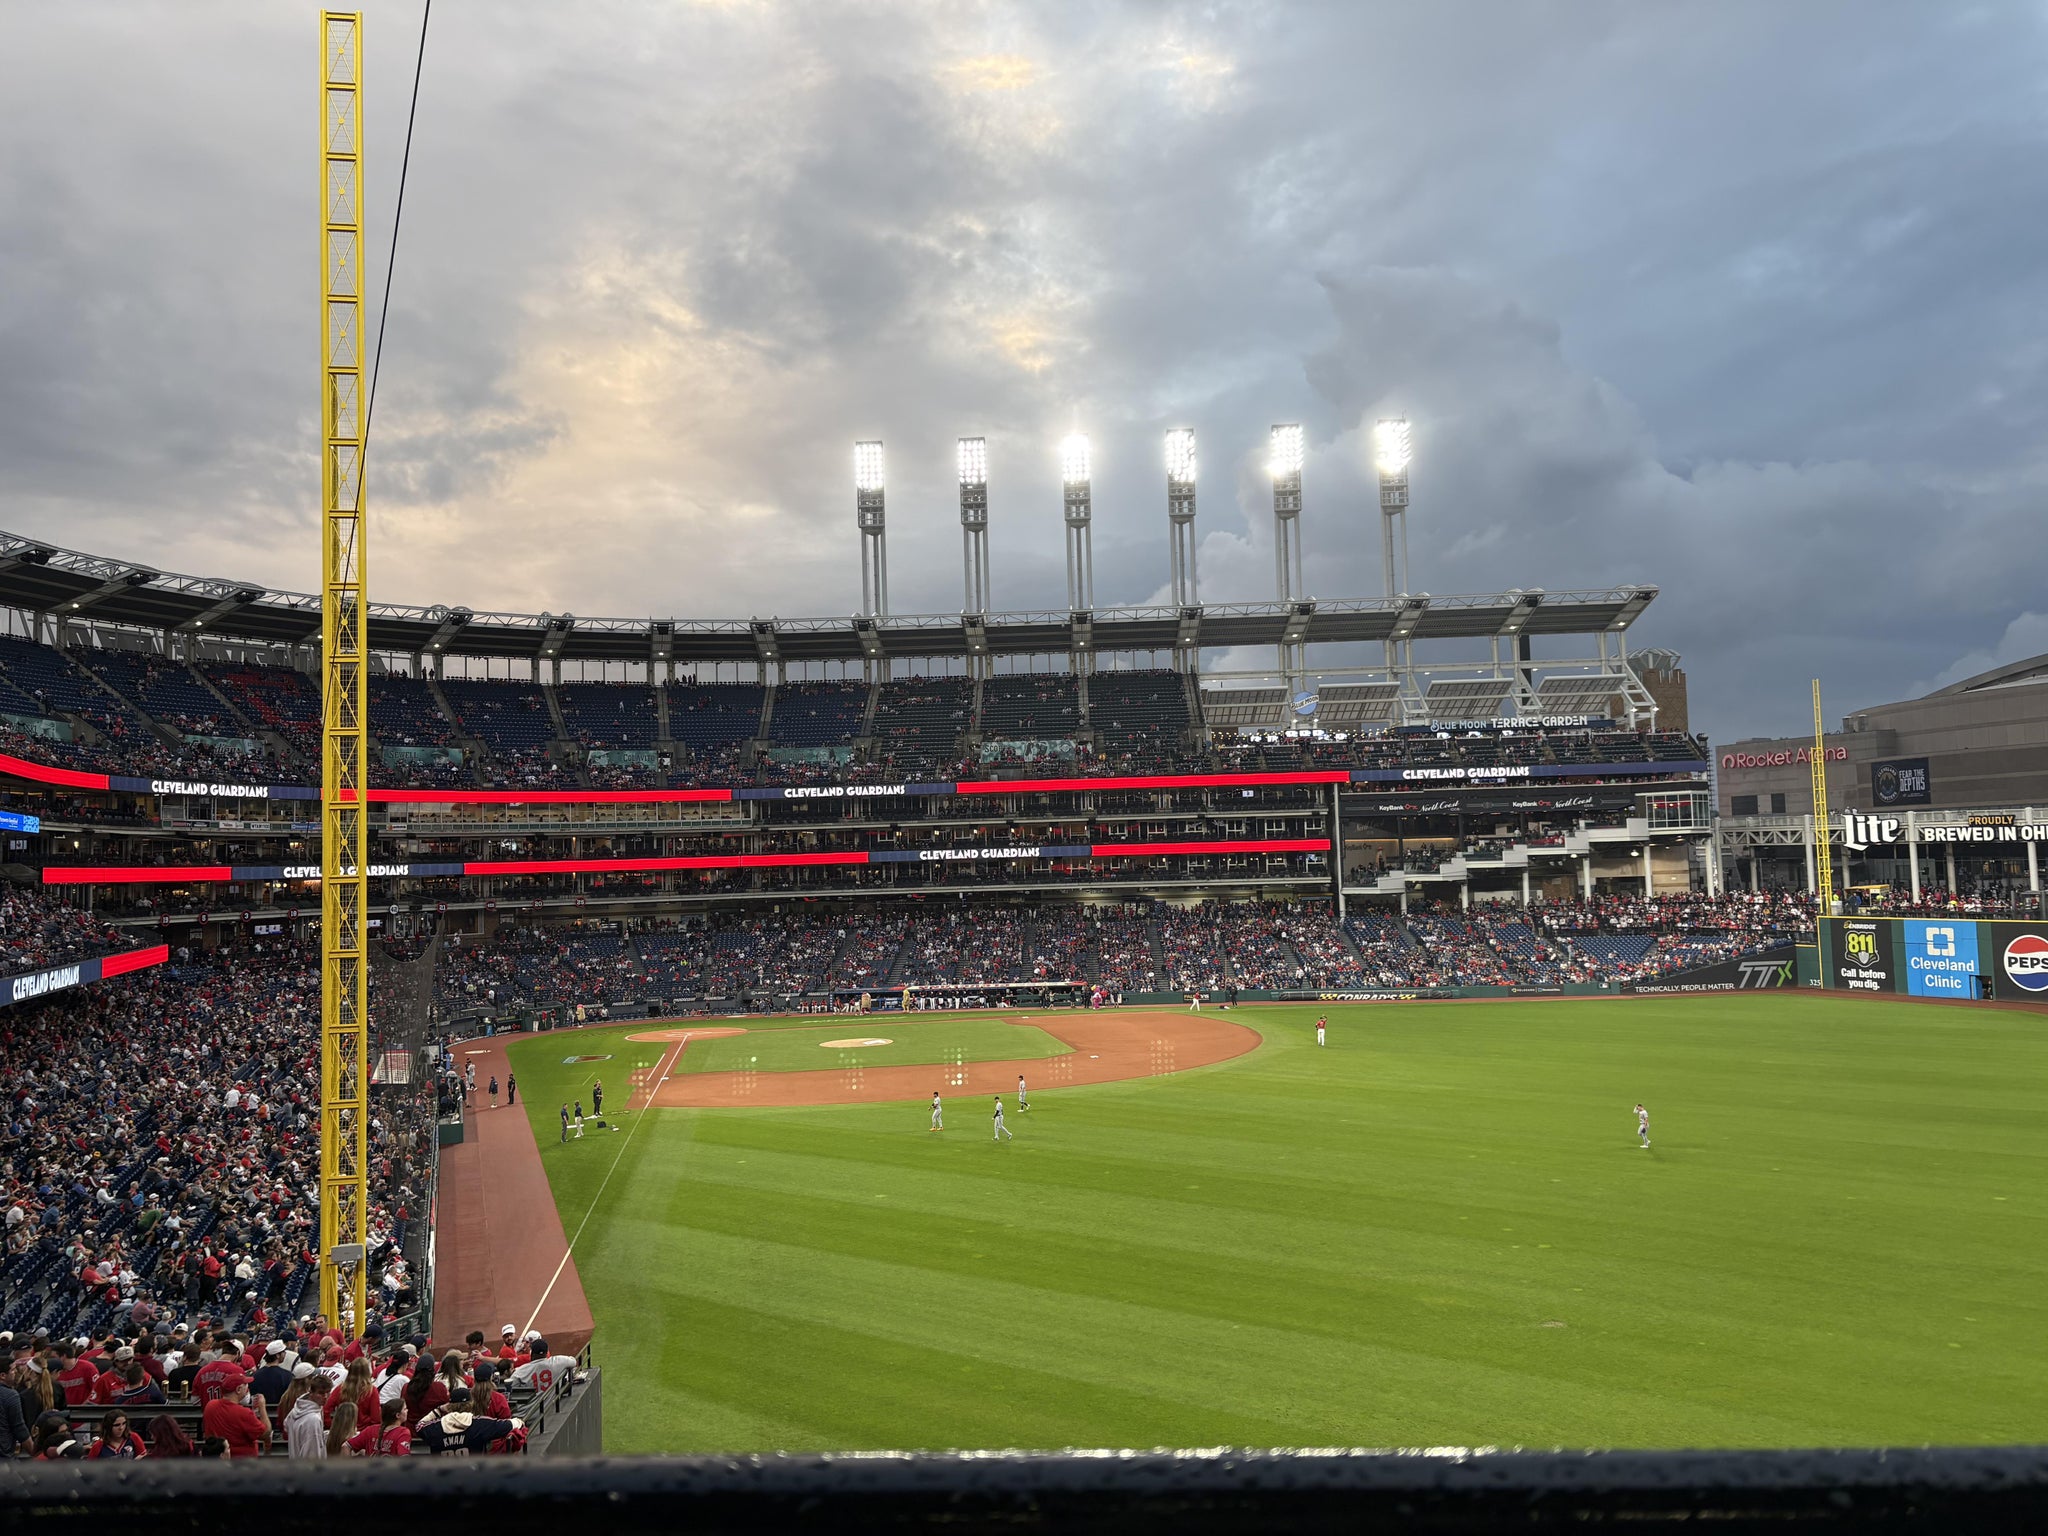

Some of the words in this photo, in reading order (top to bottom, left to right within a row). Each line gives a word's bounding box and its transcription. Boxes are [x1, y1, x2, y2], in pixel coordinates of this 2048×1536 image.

[1430, 719, 1457, 732] BLUE
[1459, 720, 1487, 730] MOON
[1490, 716, 1539, 729] TERRACE
[1542, 715, 1588, 727] GARDEN
[1737, 749, 1792, 768] Rocket
[1795, 746, 1848, 763] Arena
[1402, 769, 1465, 780] CLEVELAND
[1467, 766, 1530, 778] GUARDIANS
[1899, 769, 1912, 779] FEAR
[1914, 768, 1925, 778] THE
[151, 780, 208, 796] CLEVELAND
[209, 784, 268, 799] GUARDIANS
[784, 786, 844, 798] CLEVELAND
[846, 784, 905, 796] GUARDIANS
[1900, 777, 1926, 792] DEPTHS
[1379, 804, 1404, 812] KeyBank
[1418, 801, 1440, 813] North
[1439, 800, 1459, 810] Coast
[1551, 798, 1573, 810] North
[1572, 796, 1593, 806] Coast
[1968, 815, 2015, 825] PROUDLY
[1841, 814, 1899, 851] Lite
[1924, 826, 1994, 842] BREWED
[1998, 826, 2017, 841] IN
[920, 849, 979, 860] CLEVELAND
[981, 847, 1040, 859] GUARDIANS
[347, 864, 409, 876] GARDIANS
[1848, 933, 1874, 954] 811
[1910, 957, 1975, 973] Cleveland
[1841, 967, 1857, 978] Call
[1858, 969, 1886, 980] before
[13, 972, 49, 1000] CLEVELAND
[49, 965, 80, 991] GUARDIANS
[1681, 983, 1707, 991] PEOPLE
[1809, 979, 1821, 987] 325
[1848, 980, 1864, 989] you
[1864, 979, 1881, 991] dig.
[1925, 974, 1962, 990] Clinic
[531, 1369, 553, 1393] 19
[206, 1385, 222, 1400] 11
[444, 1435, 466, 1448] KWAN
